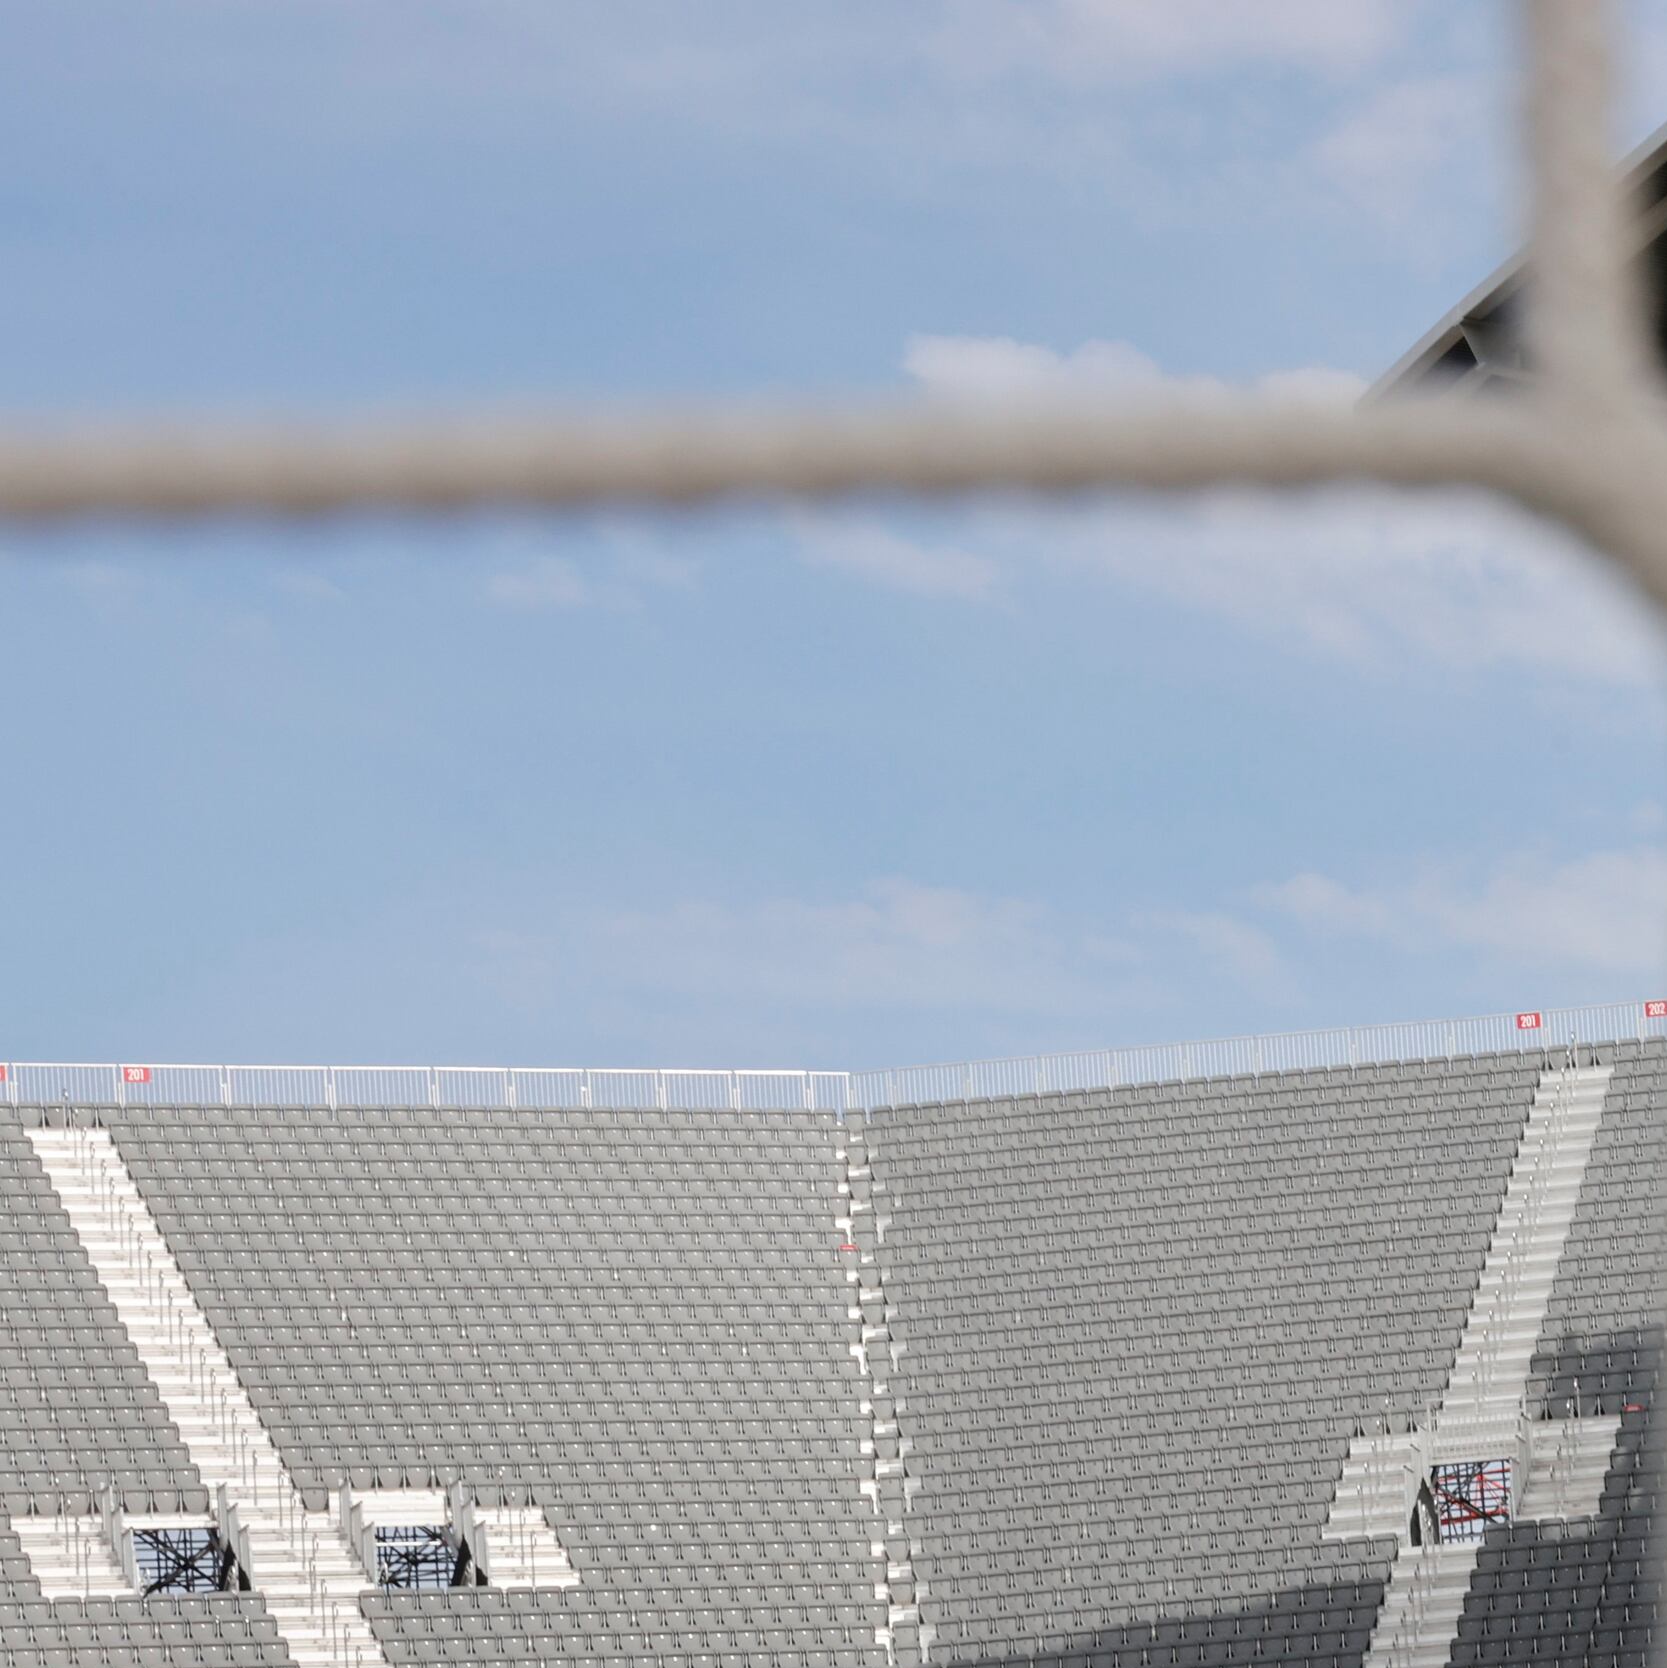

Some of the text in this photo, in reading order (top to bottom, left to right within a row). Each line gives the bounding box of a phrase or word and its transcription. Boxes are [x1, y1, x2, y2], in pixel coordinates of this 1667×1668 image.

[1648, 1002, 1666, 1016] 202
[1520, 1014, 1536, 1028] 201
[127, 1068, 145, 1081] 201
